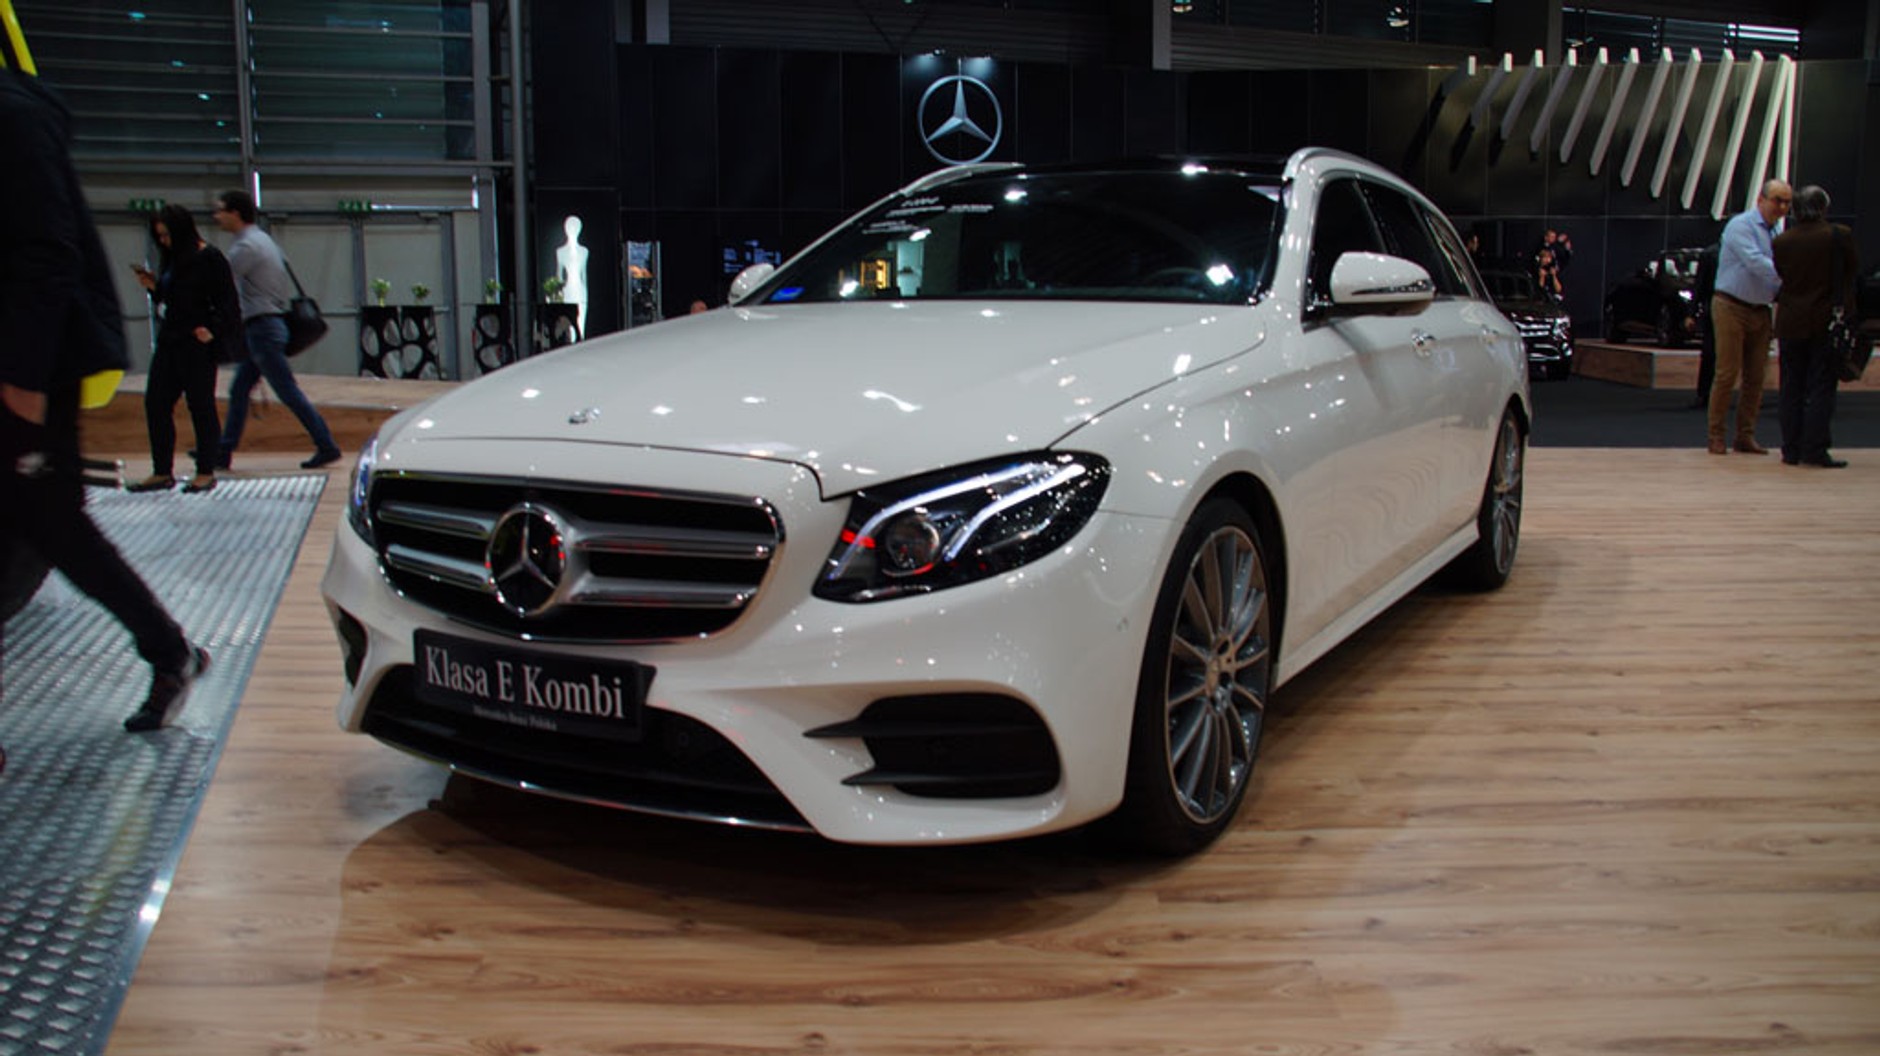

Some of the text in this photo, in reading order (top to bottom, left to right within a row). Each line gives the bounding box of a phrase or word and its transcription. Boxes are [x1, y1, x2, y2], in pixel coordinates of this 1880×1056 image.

[425, 645, 490, 698] Klasa
[497, 660, 515, 702] E
[522, 664, 625, 719] Kombi
